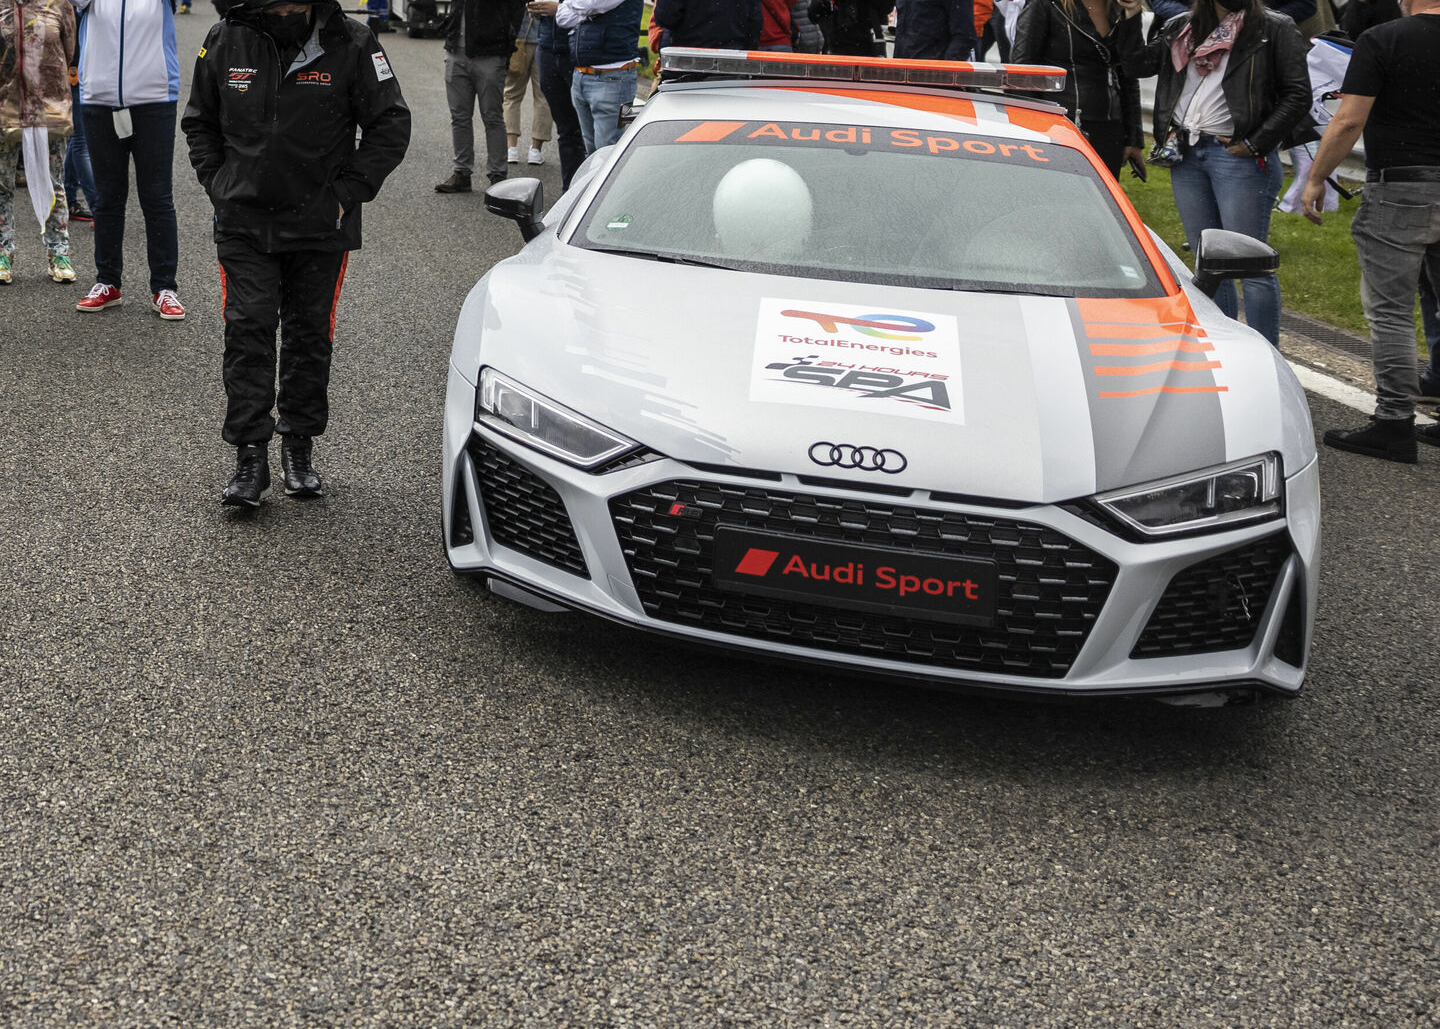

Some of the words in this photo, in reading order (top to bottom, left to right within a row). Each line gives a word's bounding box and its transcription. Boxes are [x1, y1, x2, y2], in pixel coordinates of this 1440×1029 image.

[296, 71, 332, 82] SRO
[746, 123, 871, 144] Audi
[890, 130, 1049, 162] Sport
[778, 334, 938, 359] TotalEnergies
[816, 360, 855, 369] 24
[858, 365, 949, 381] HOURS
[783, 365, 951, 409] SPA
[782, 554, 864, 585] Audi
[875, 566, 979, 600] Sport
